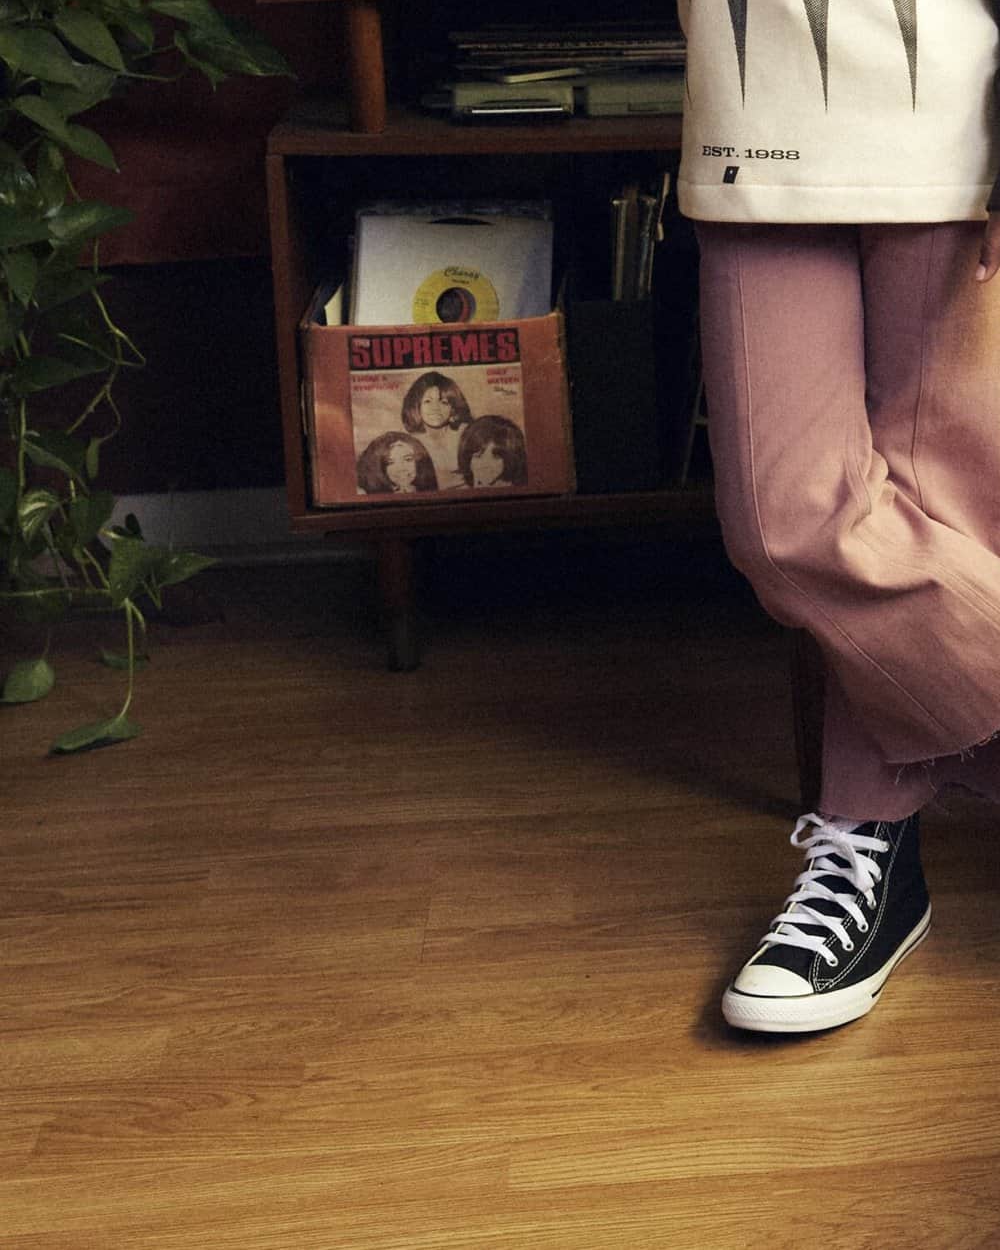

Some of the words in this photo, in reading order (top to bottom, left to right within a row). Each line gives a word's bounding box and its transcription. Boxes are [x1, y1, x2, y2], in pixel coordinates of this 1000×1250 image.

[702, 145, 740, 158] EST.
[744, 148, 800, 160] 1988
[352, 331, 517, 368] SUPREMES
